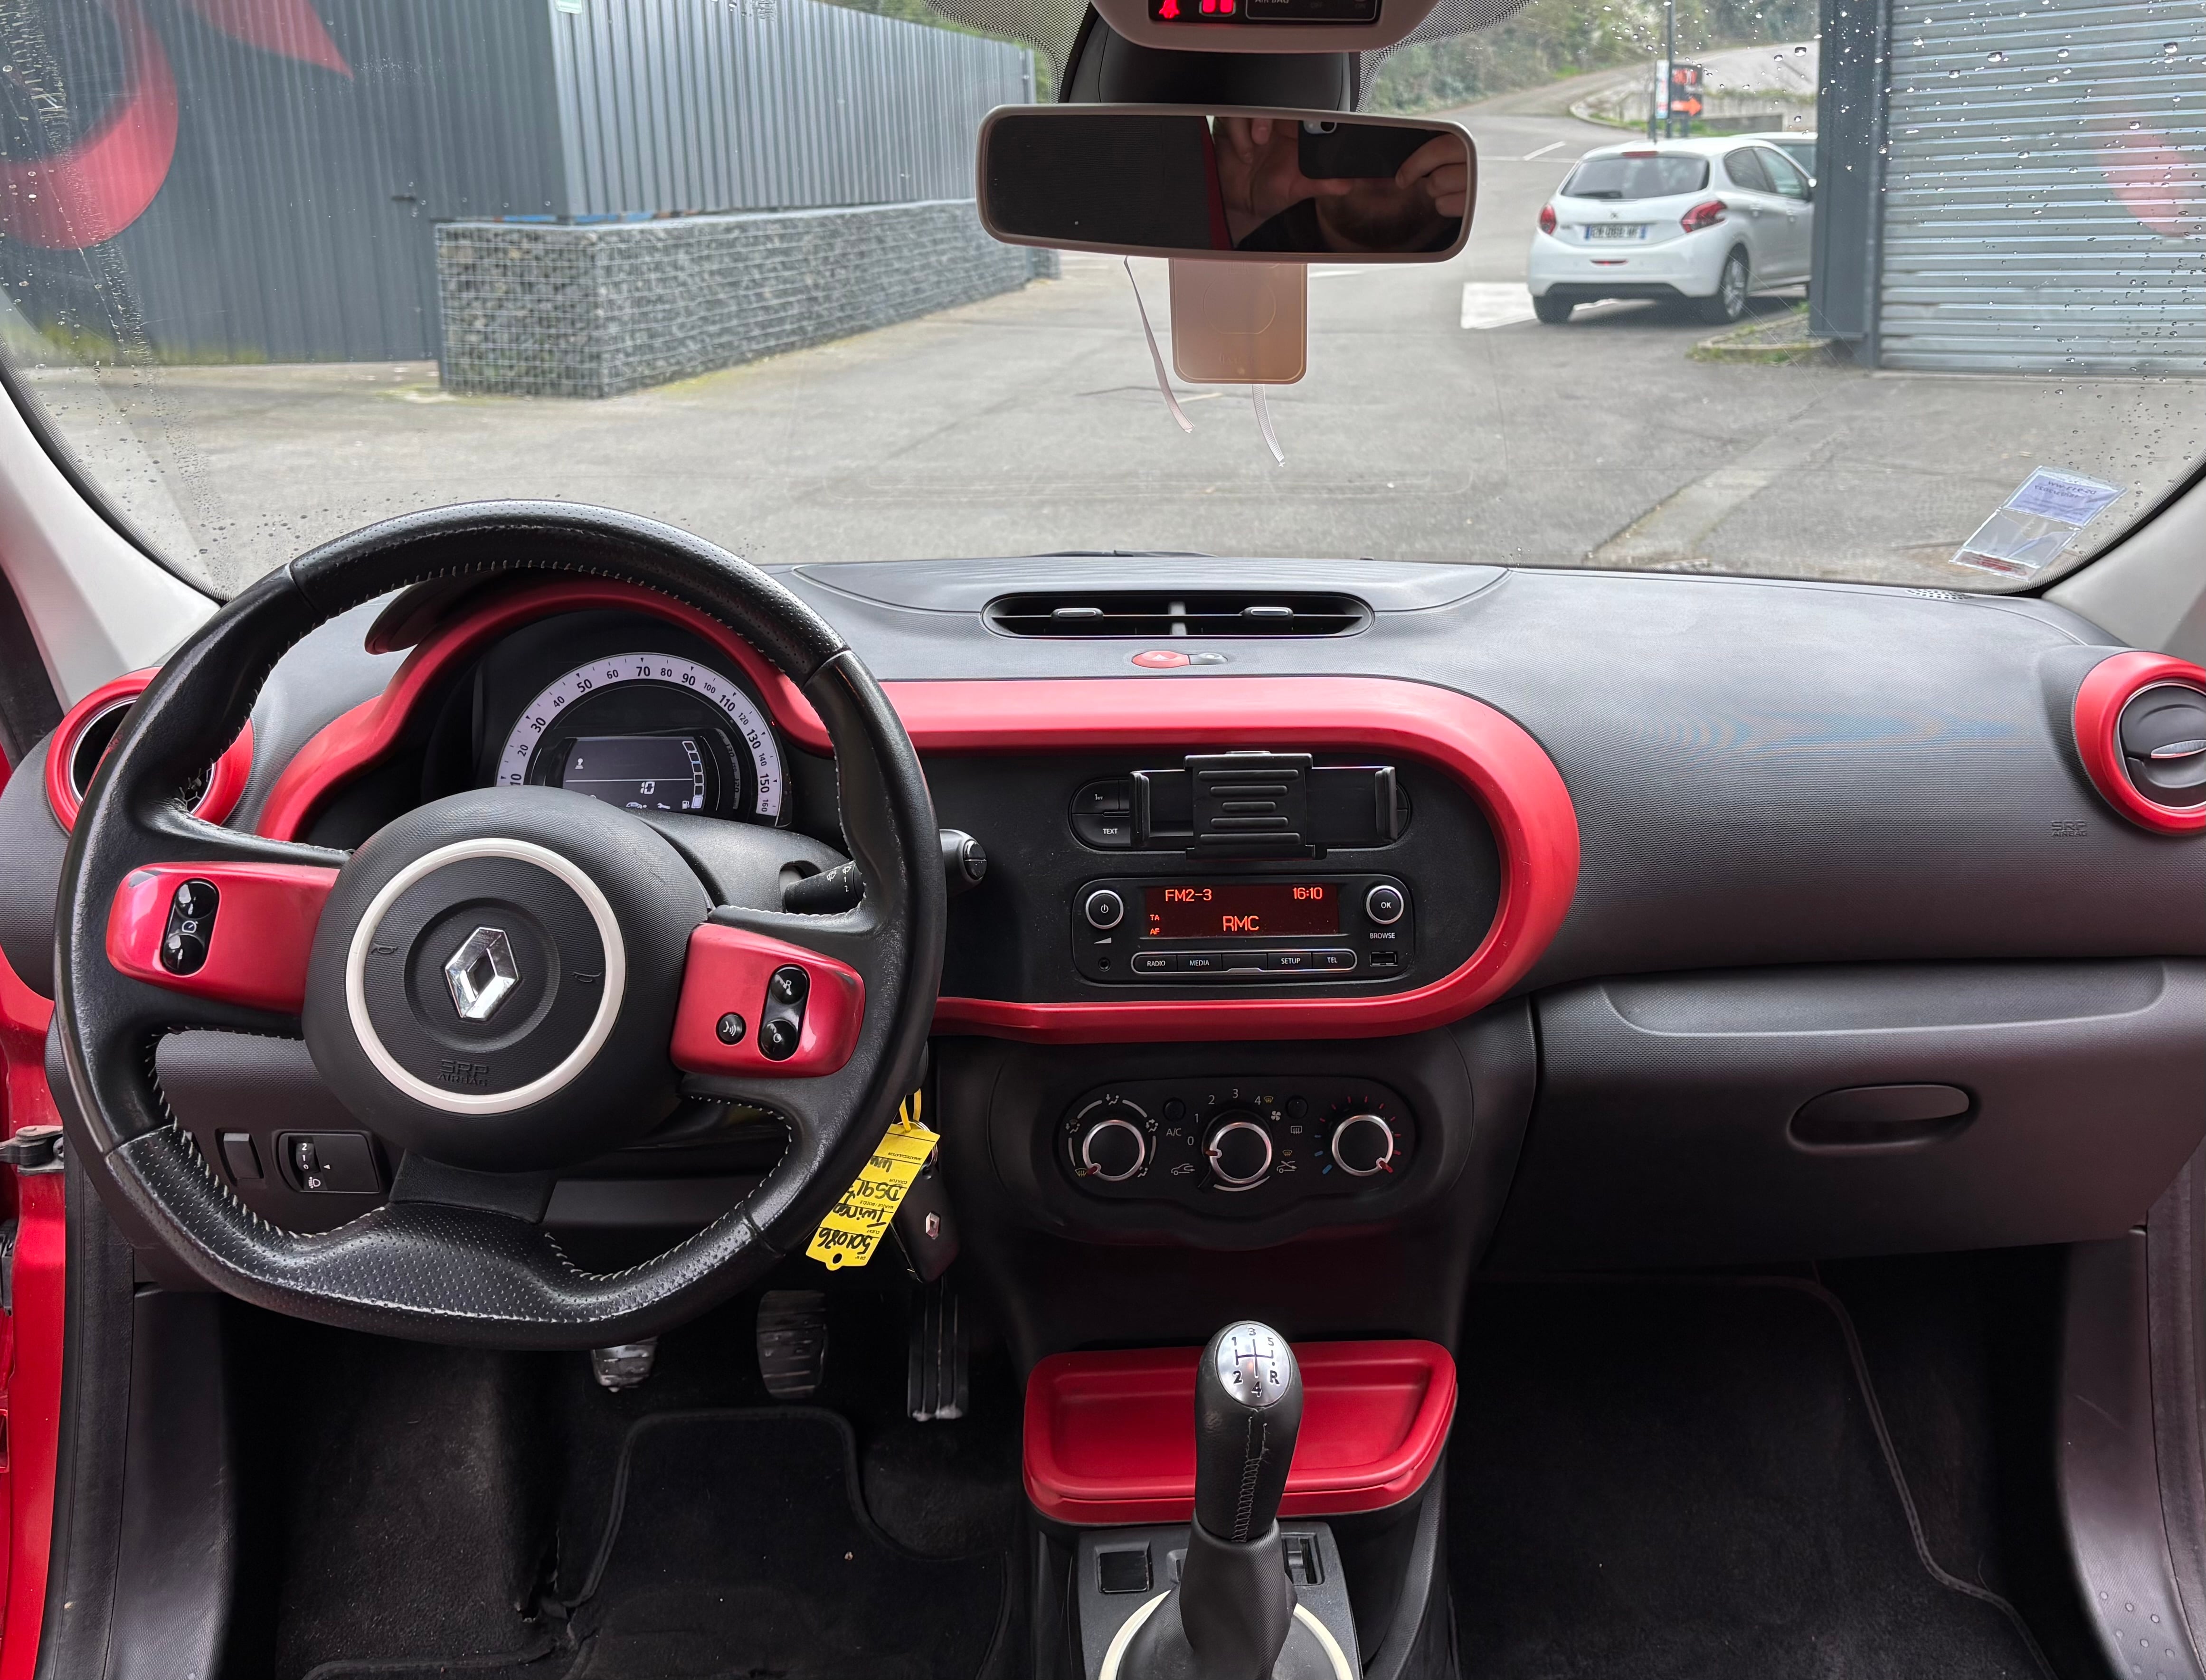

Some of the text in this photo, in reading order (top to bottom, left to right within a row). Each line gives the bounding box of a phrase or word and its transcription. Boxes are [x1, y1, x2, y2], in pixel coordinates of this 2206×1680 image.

[606, 669, 619, 679] 60
[636, 666, 650, 677] 70
[660, 668, 672, 677] 80
[682, 673, 696, 686] 90
[577, 679, 592, 693] 50
[703, 682, 716, 694] 100
[553, 696, 565, 708] 40
[719, 695, 736, 712] 110
[530, 717, 546, 733] 30
[738, 712, 749, 726] 120
[747, 729, 761, 749] 130
[517, 744, 529, 757] 20
[758, 753, 767, 766] 140
[510, 773, 522, 786] 10
[760, 773, 770, 793] 150
[1165, 888, 1212, 902] FM2-3
[1292, 887, 1323, 899] 16:10
[1223, 915, 1259, 931] RMC
[1232, 1089, 1239, 1098] 3
[1208, 1095, 1215, 1105] 2
[1254, 1095, 1261, 1105] 4
[1194, 1113, 1198, 1123] 1
[1166, 1128, 1182, 1136] A/C
[302, 1142, 307, 1151] 2
[1248, 1327, 1256, 1336] 3
[1231, 1337, 1237, 1346] 1
[1267, 1337, 1274, 1346] 5
[1233, 1370, 1243, 1385] 2
[1269, 1370, 1280, 1385] R
[1251, 1381, 1262, 1397] 4
